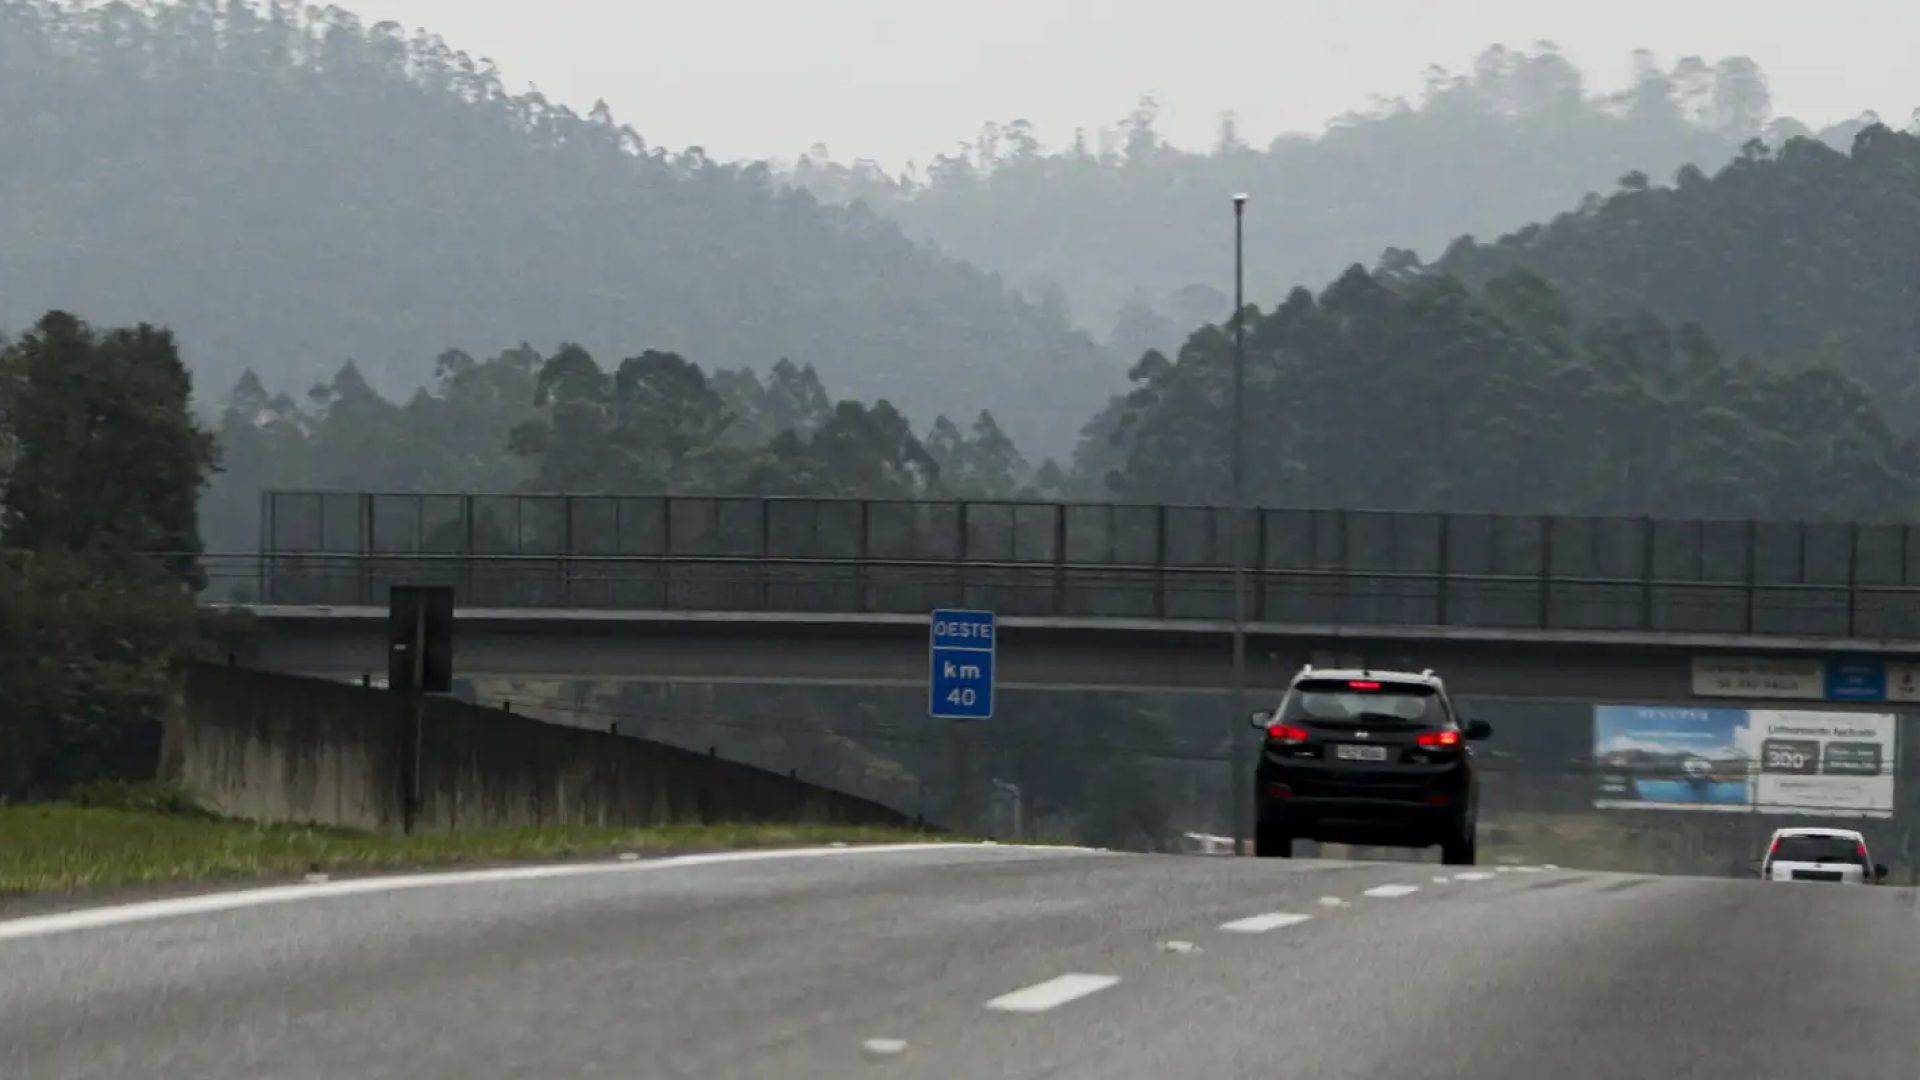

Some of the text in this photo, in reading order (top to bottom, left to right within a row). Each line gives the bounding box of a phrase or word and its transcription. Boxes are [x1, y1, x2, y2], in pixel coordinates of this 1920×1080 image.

[934, 621, 993, 638] OESTE
[943, 661, 981, 679] km
[946, 688, 977, 706] 40
